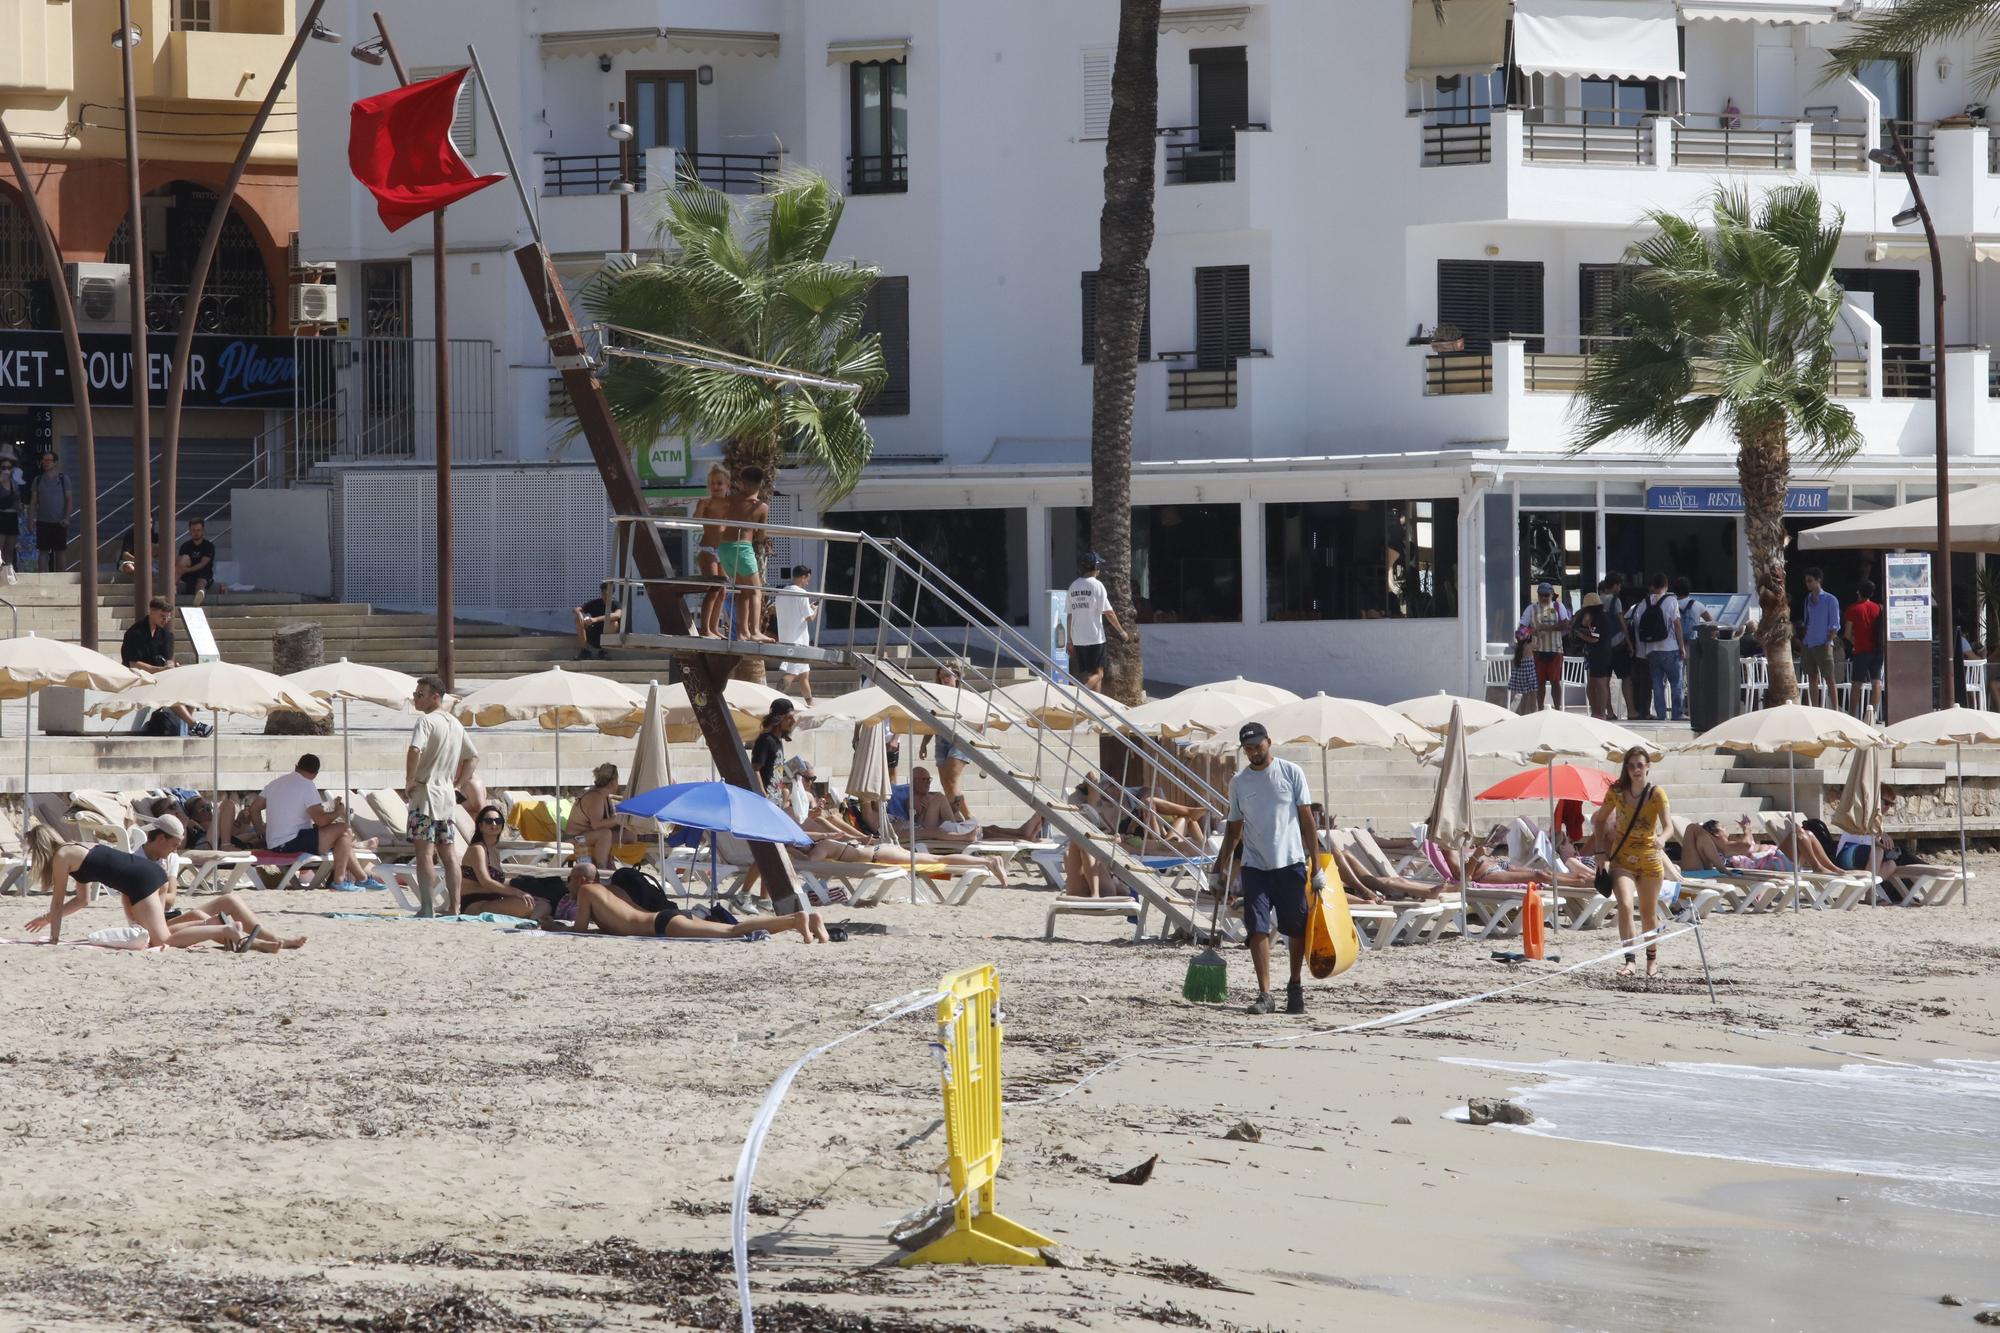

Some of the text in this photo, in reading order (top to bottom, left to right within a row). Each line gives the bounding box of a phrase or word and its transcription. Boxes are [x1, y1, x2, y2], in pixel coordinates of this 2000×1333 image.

[0, 350, 49, 387] KET
[215, 340, 304, 395] Plaza
[651, 450, 682, 462] ATM
[1658, 487, 1699, 510] MARYCEL
[1798, 493, 1822, 508] BAR
